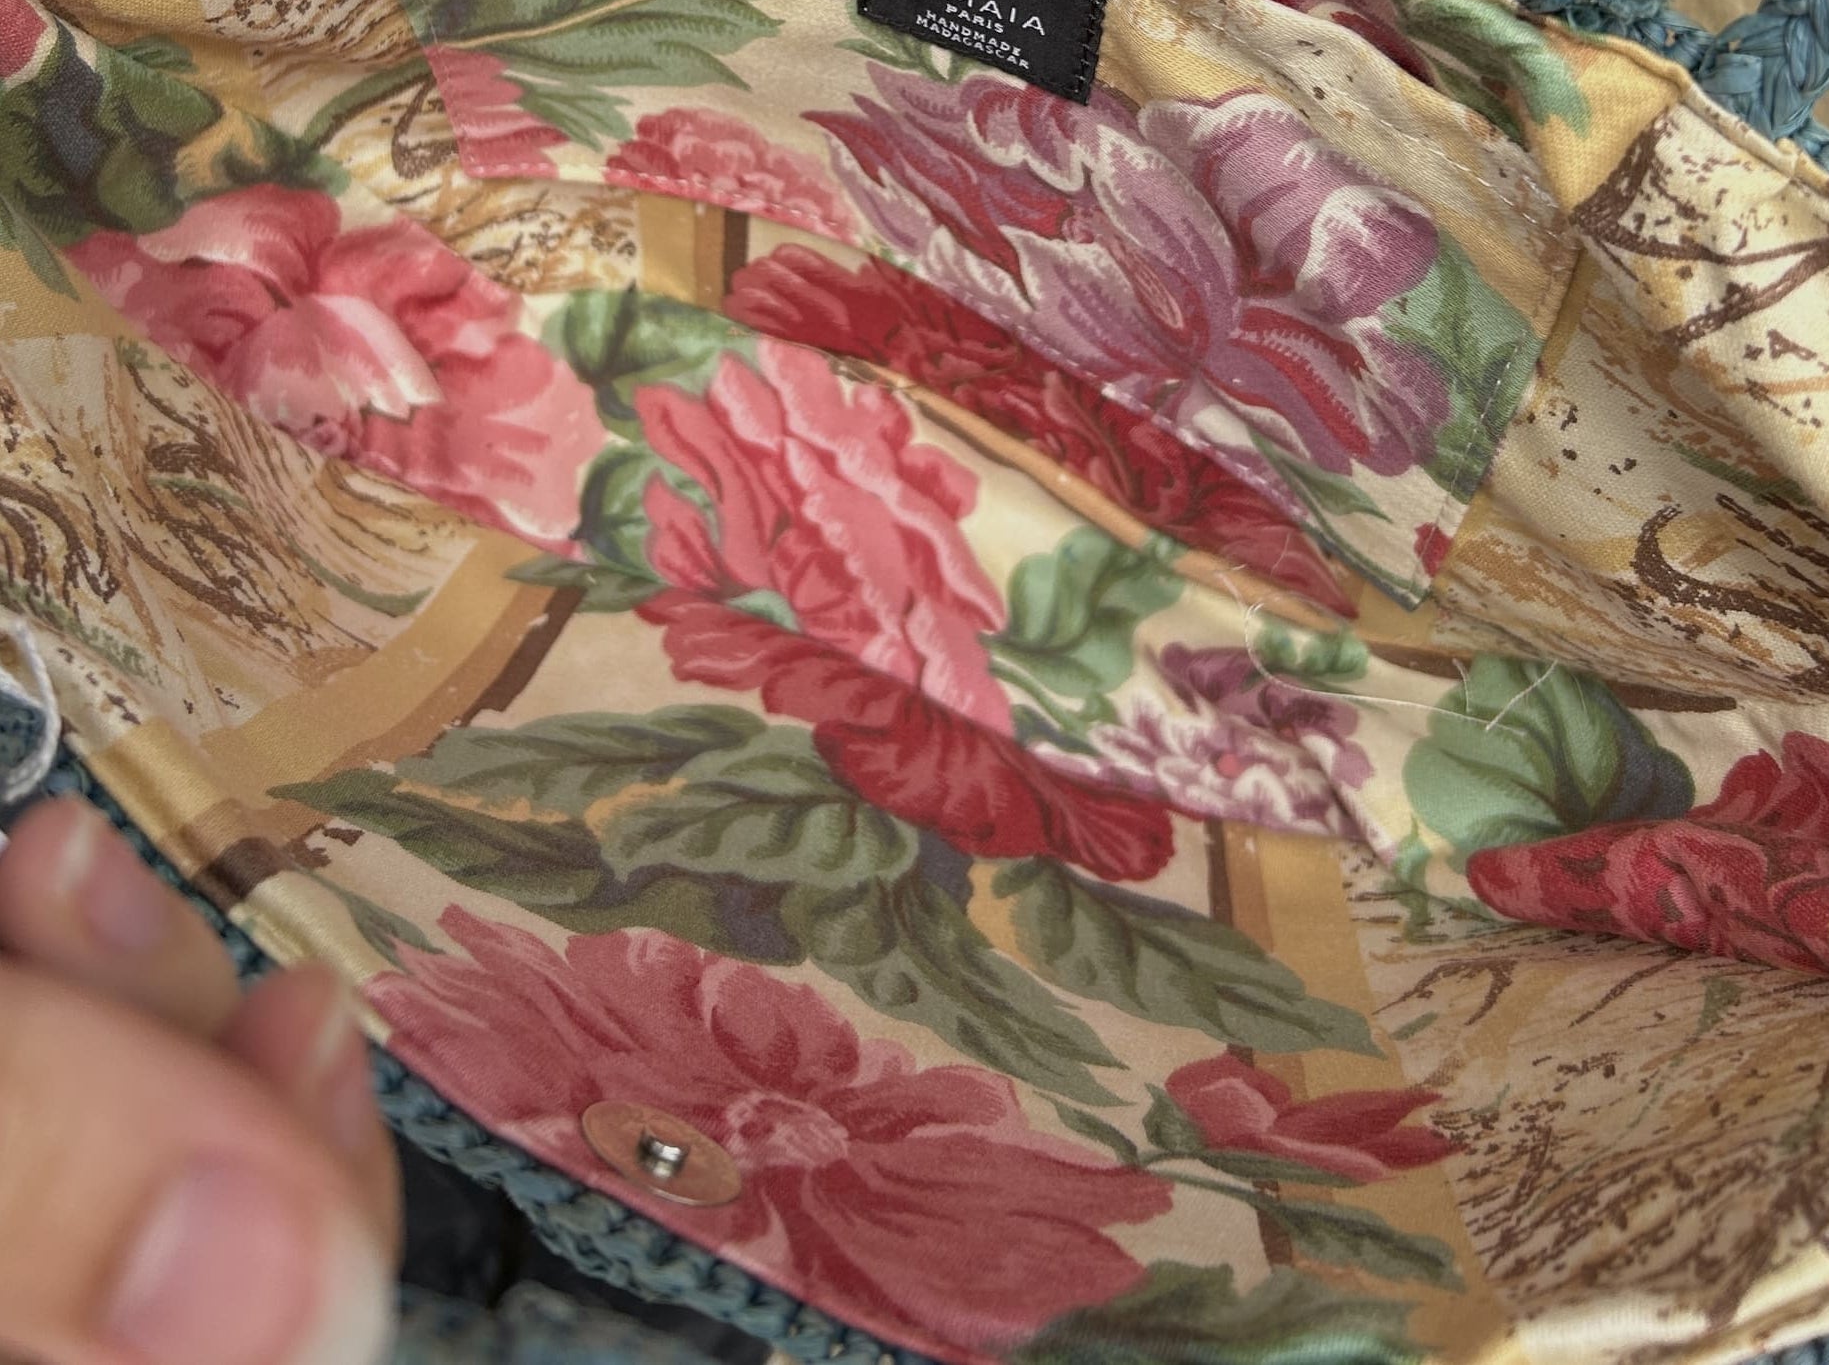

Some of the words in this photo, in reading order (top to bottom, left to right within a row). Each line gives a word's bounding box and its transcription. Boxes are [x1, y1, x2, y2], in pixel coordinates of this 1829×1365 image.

[926, 10, 1022, 56] HANDMADE
[945, 3, 1004, 33] PARIS
[916, 15, 1030, 69] MADAGASCAR
